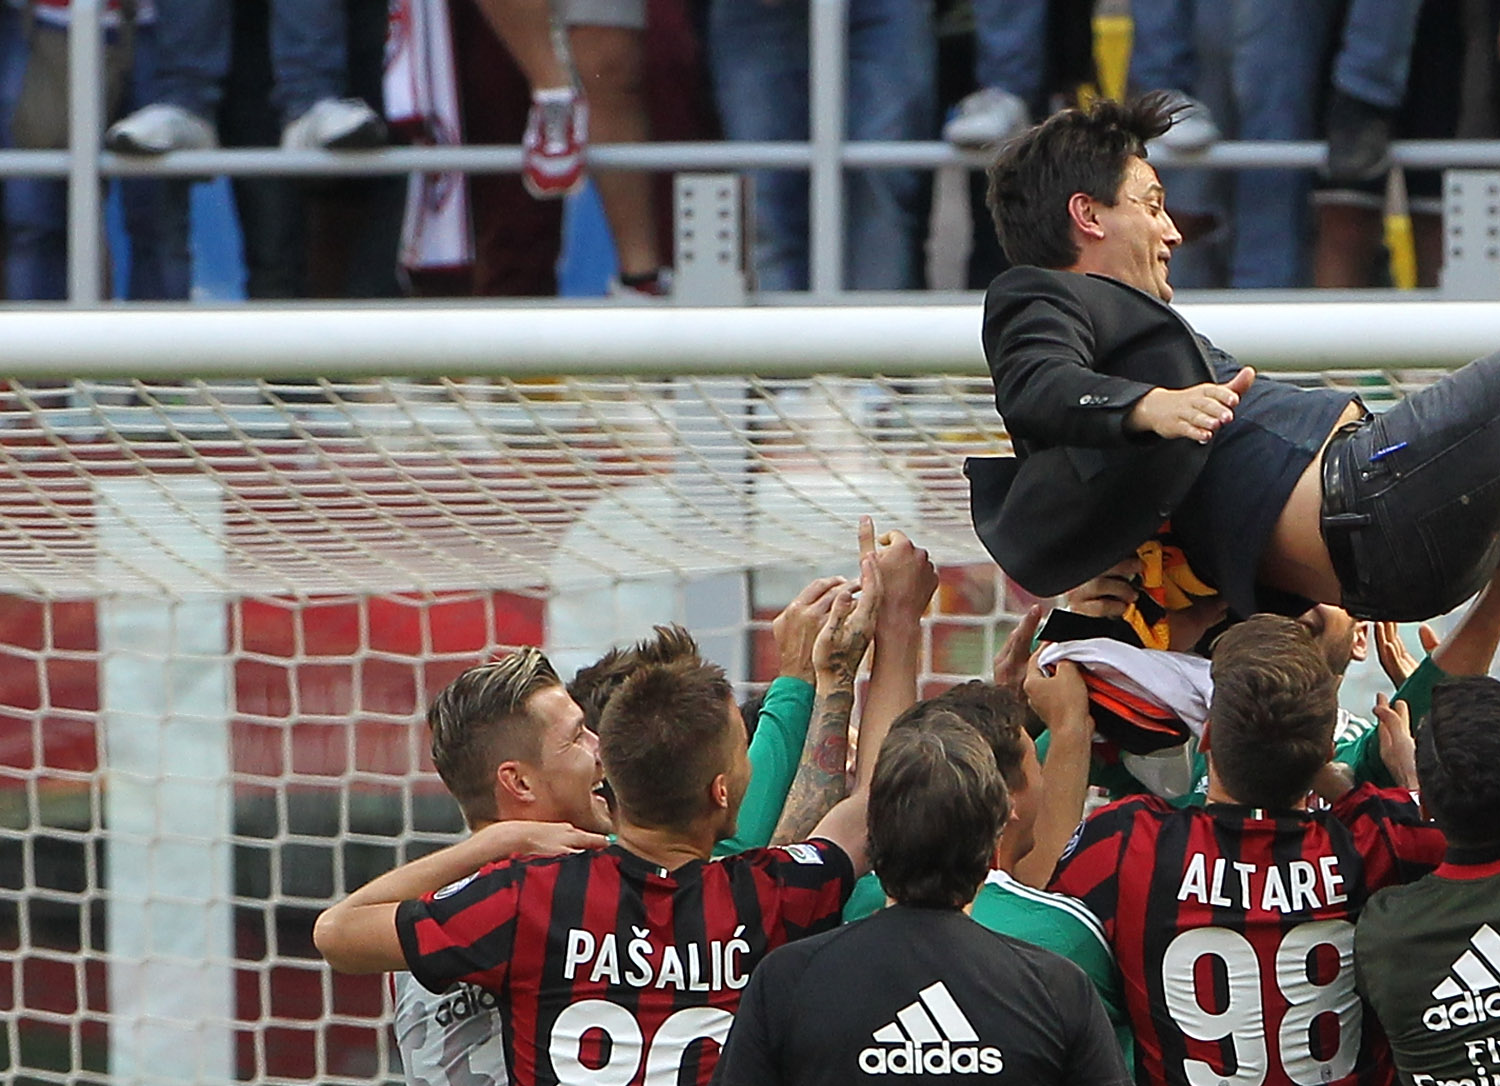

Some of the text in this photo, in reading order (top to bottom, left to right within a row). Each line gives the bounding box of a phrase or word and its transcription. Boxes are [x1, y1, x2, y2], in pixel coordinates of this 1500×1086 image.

[1176, 853, 1348, 913] ALTARE
[563, 924, 751, 992] PAŠALIĆ
[858, 1040, 1004, 1074] adidas
